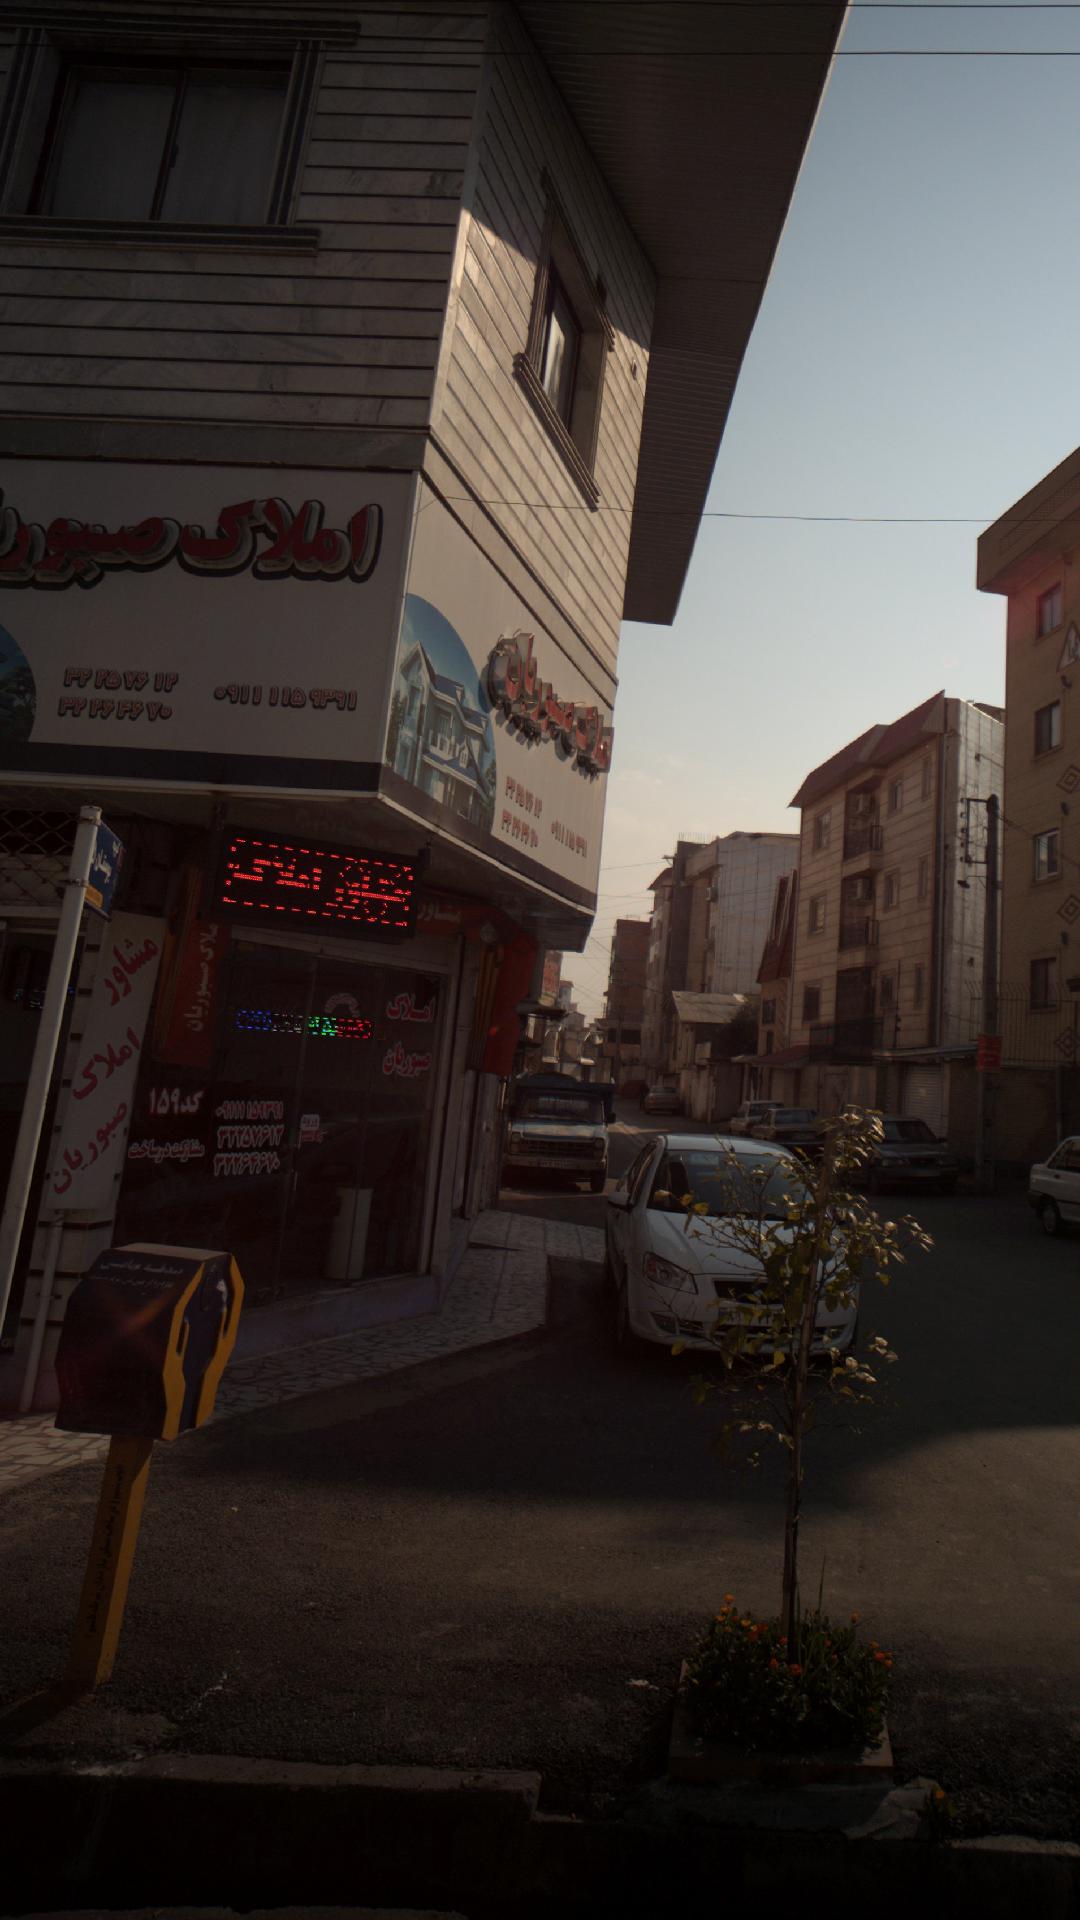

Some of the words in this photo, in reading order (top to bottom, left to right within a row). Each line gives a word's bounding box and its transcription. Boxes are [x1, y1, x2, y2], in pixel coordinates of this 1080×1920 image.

[0, 487, 182, 591] صبور
[177, 497, 383, 583] املاک
[104, 938, 159, 1007] مشاور
[72, 1026, 140, 1100] املاک
[53, 1102, 128, 1194] صبوریان
